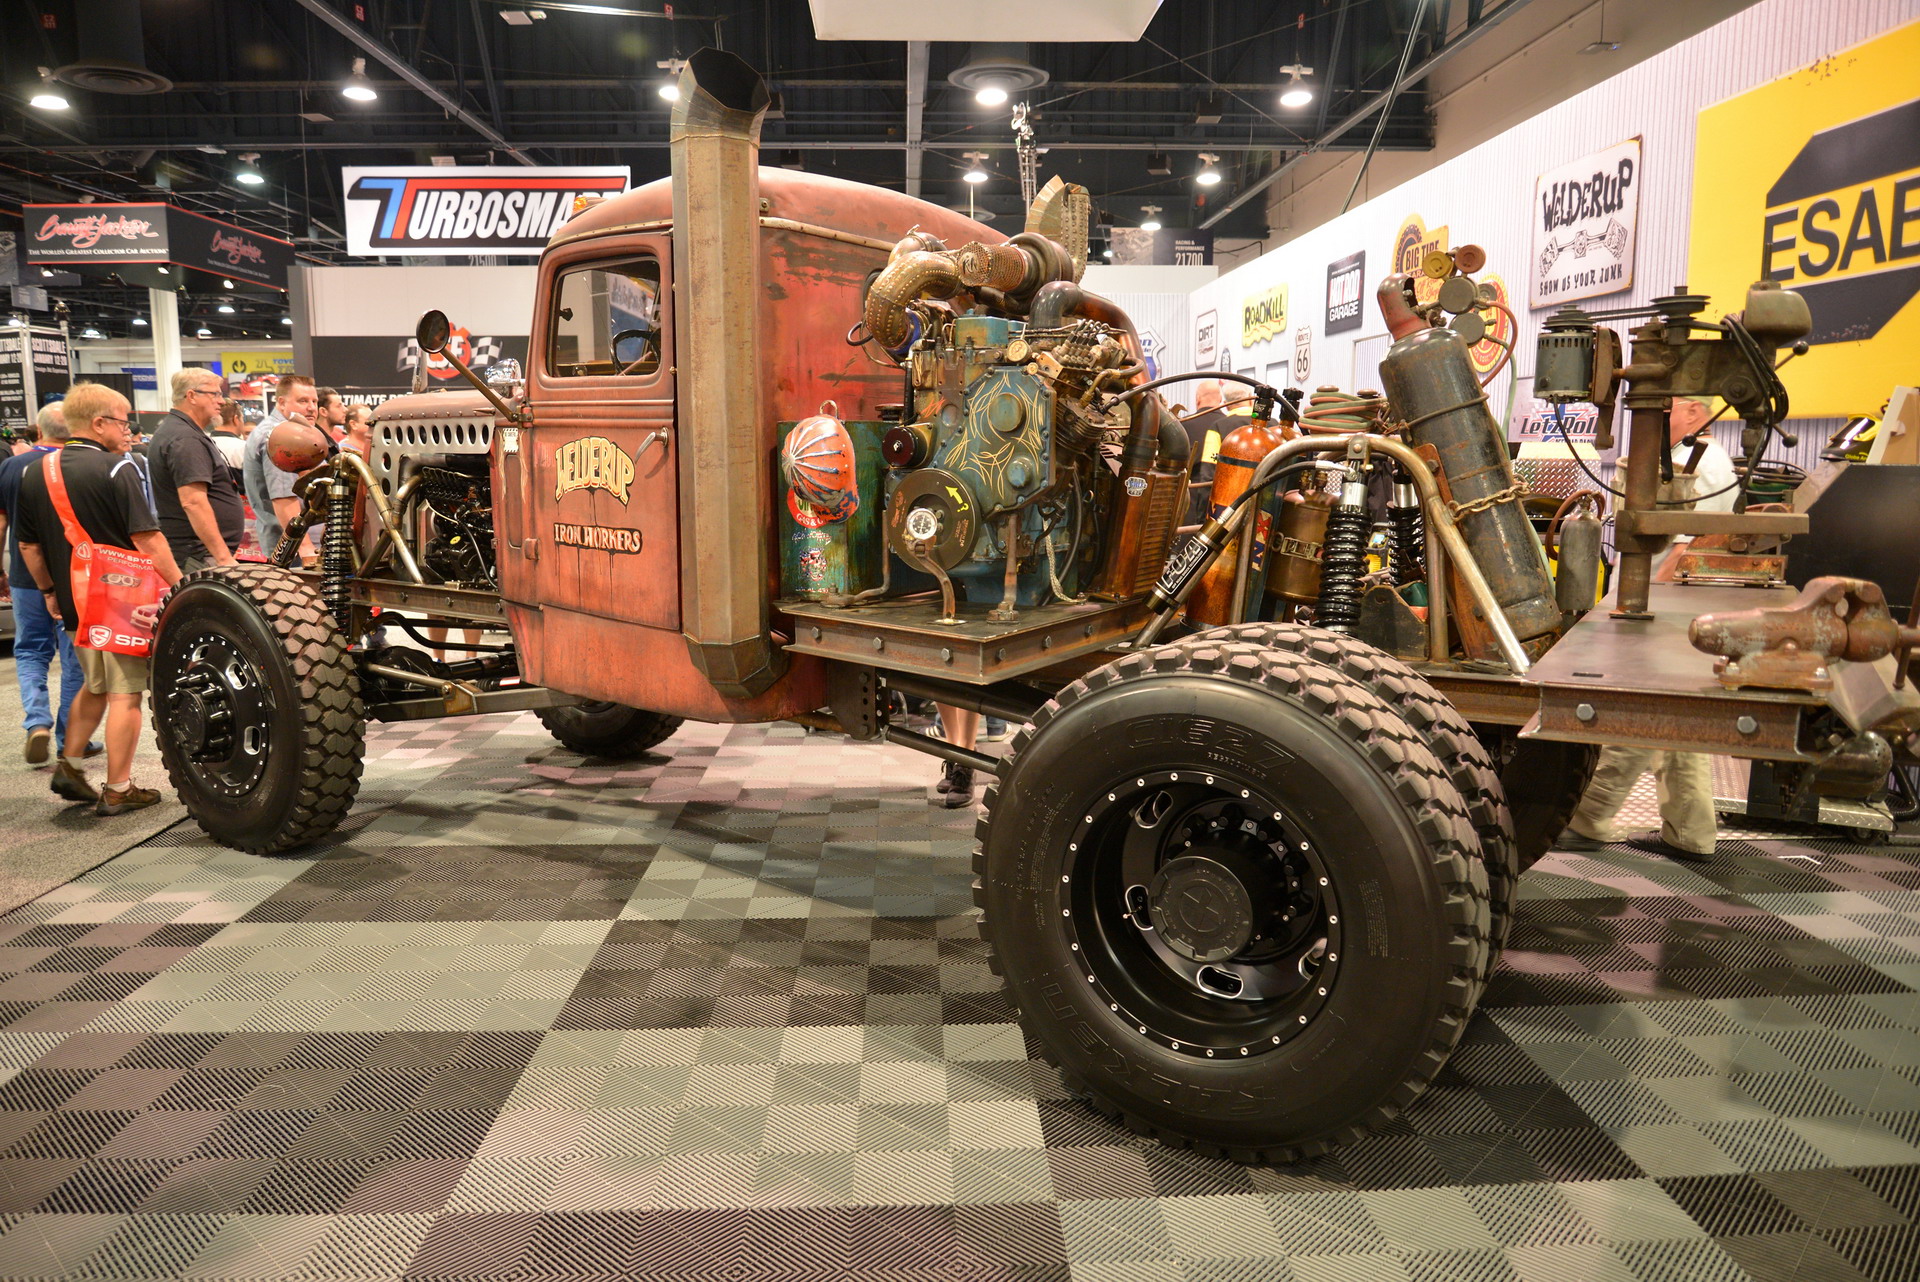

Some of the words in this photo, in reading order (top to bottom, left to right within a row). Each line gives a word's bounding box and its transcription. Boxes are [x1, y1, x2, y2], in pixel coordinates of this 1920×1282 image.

[357, 178, 627, 241] TURBOSMA
[1542, 158, 1633, 233] WELDERUP
[1405, 246, 1420, 273] BIG
[1329, 274, 1345, 309] HOT
[1343, 268, 1361, 304] ROD
[1540, 278, 1559, 297] SHOW
[1562, 275, 1571, 292] US
[1574, 269, 1596, 289] YOUR
[1599, 263, 1623, 284] JUNK
[1244, 293, 1284, 333] ROADKILL
[1329, 300, 1359, 322] GARAGE
[1198, 324, 1214, 342] DIRT
[1297, 348, 1309, 373] 66
[338, 393, 388, 406] LTIMATE
[554, 436, 635, 507] WELDERUP
[554, 523, 582, 545] IRON
